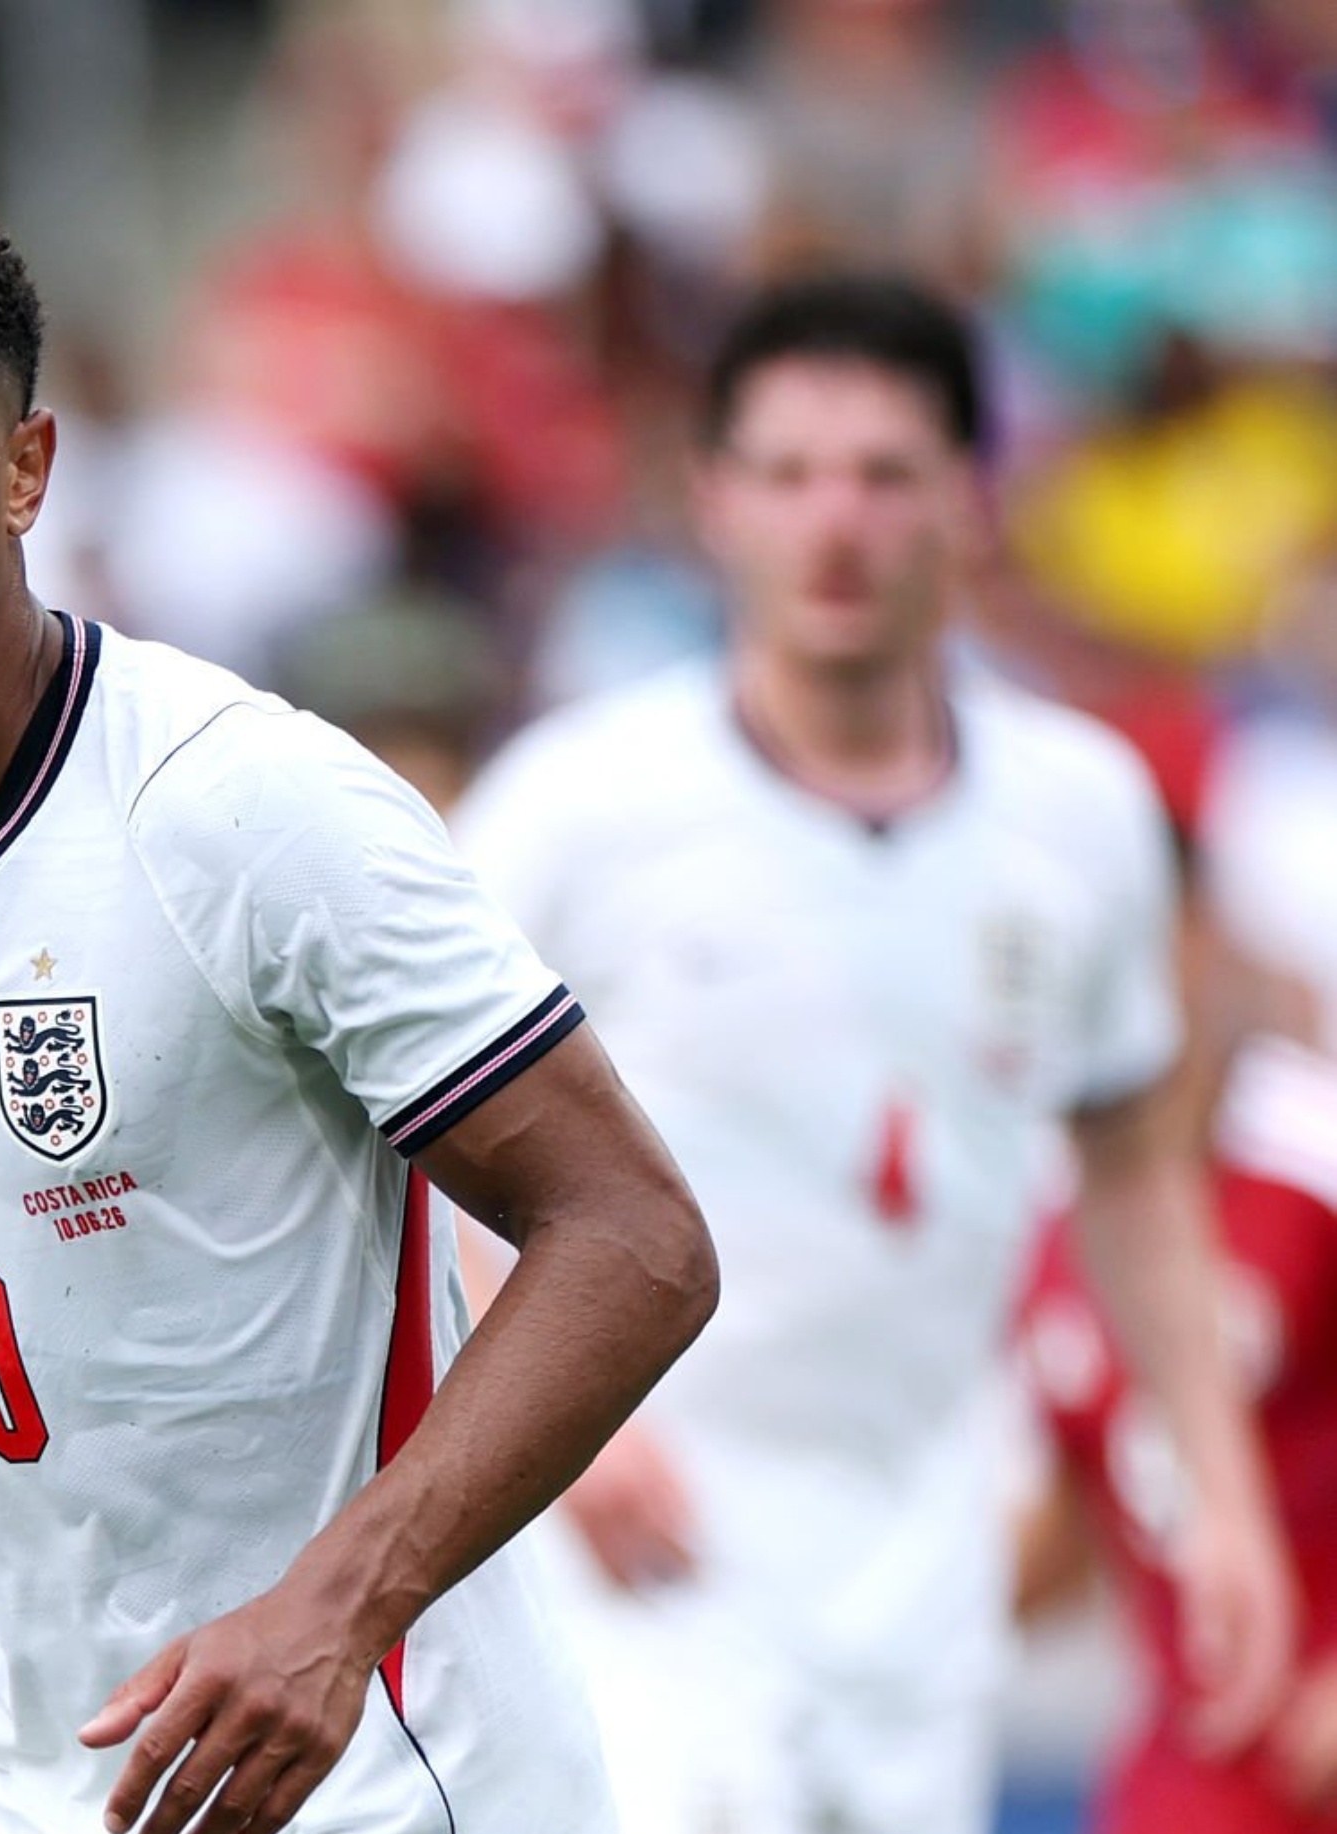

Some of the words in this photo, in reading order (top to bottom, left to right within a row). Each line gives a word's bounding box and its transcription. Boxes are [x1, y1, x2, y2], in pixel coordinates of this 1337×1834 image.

[22, 1184, 85, 1216] COSTA
[82, 1171, 137, 1201] RICA
[53, 1206, 126, 1242] 10.06.26
